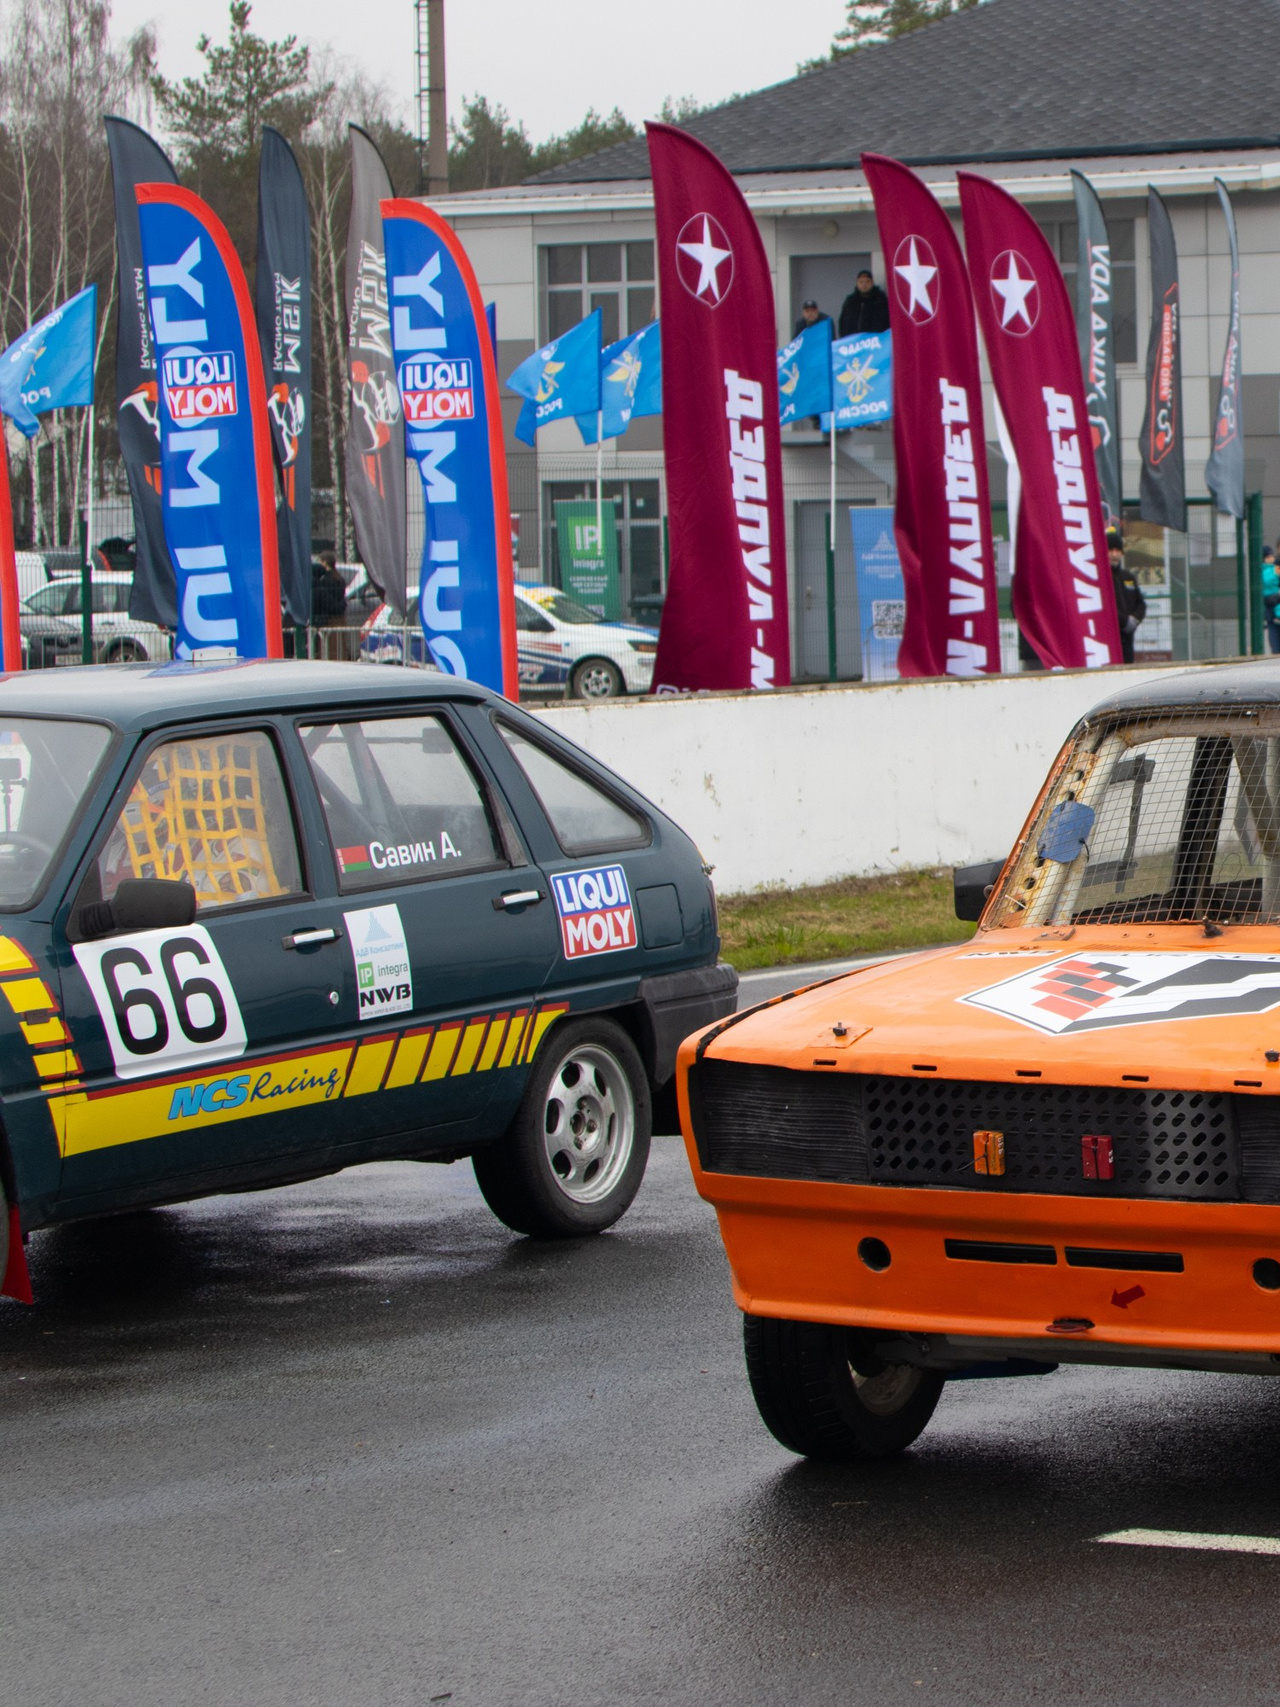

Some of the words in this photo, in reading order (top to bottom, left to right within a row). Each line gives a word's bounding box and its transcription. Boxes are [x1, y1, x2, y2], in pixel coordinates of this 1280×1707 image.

[369, 841, 437, 869] Савин
[440, 831, 462, 859] А.
[556, 869, 627, 913] LIQUI
[565, 908, 631, 954] MOLY
[360, 967, 373, 984] IP
[377, 962, 409, 977] integra
[100, 936, 228, 1056] 66
[360, 983, 412, 1008] NWB
[168, 1075, 250, 1121] NCS
[250, 1068, 341, 1102] Racing
